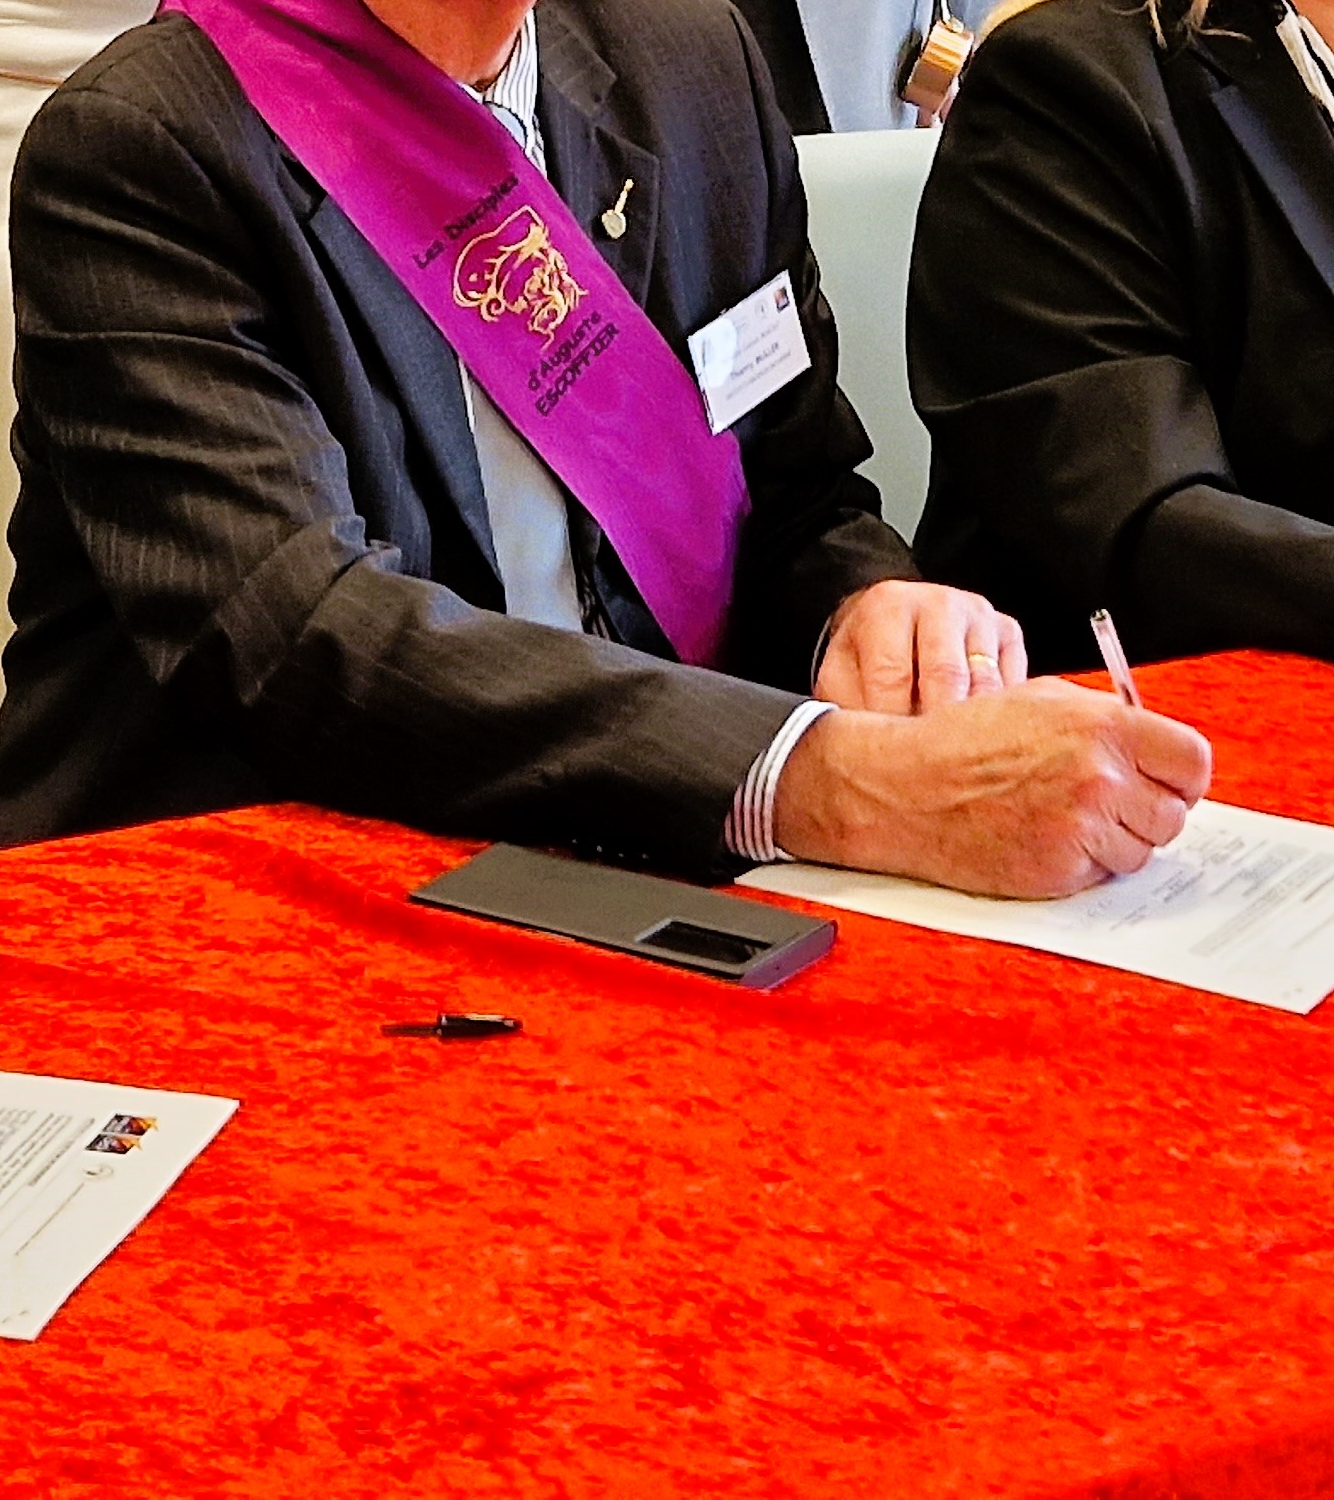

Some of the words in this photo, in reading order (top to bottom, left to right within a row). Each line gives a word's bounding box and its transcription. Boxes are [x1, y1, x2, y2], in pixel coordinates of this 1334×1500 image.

[445, 172, 519, 240] Disciples
[528, 311, 601, 391] d'Auguste
[535, 322, 620, 417] ESCOFFIER
